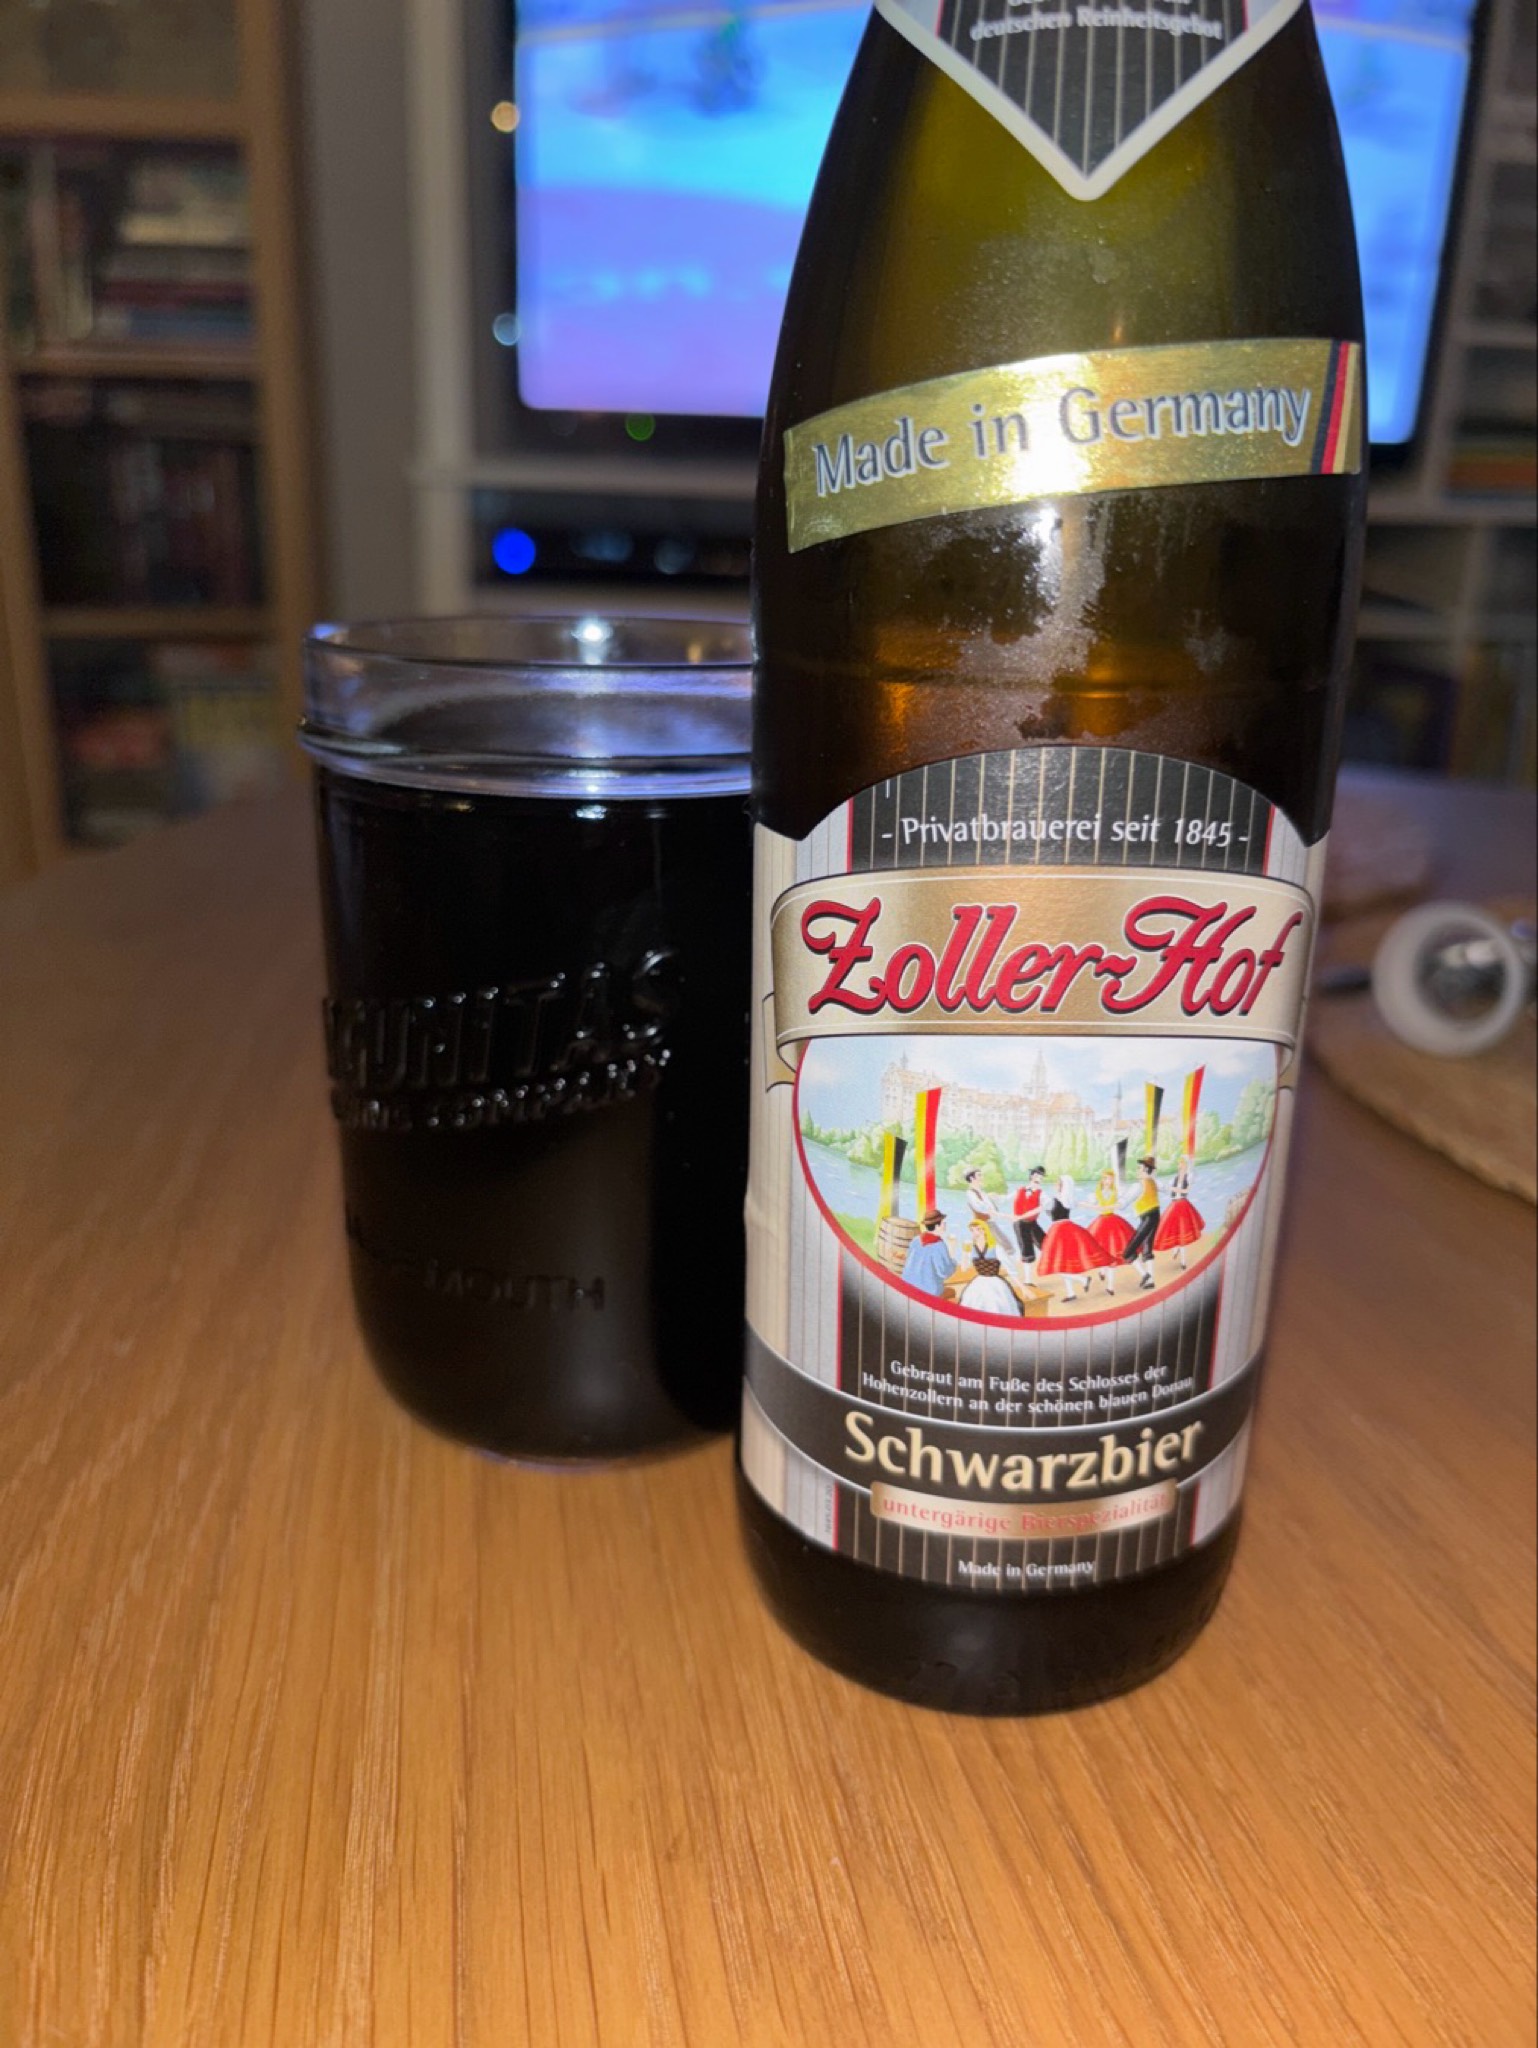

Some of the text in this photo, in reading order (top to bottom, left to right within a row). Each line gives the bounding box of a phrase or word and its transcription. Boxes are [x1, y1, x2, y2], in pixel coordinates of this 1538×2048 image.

[970, 5, 1224, 41] deutschen Reinheitsgebot
[812, 387, 1311, 497] Made in Germany
[902, 814, 1101, 847] Privatbrauerei
[1112, 815, 1160, 844] seit
[1174, 819, 1231, 846] 1845
[863, 1371, 1193, 1413] Hohenzollern an der schönen blauen Donau
[890, 1359, 1168, 1393] Gebraut am Fuße des Schlosses der
[844, 1410, 1204, 1493] Schwarzbier
[883, 1497, 1012, 1534] untergärige
[958, 1559, 1094, 1580] Made in Germany
